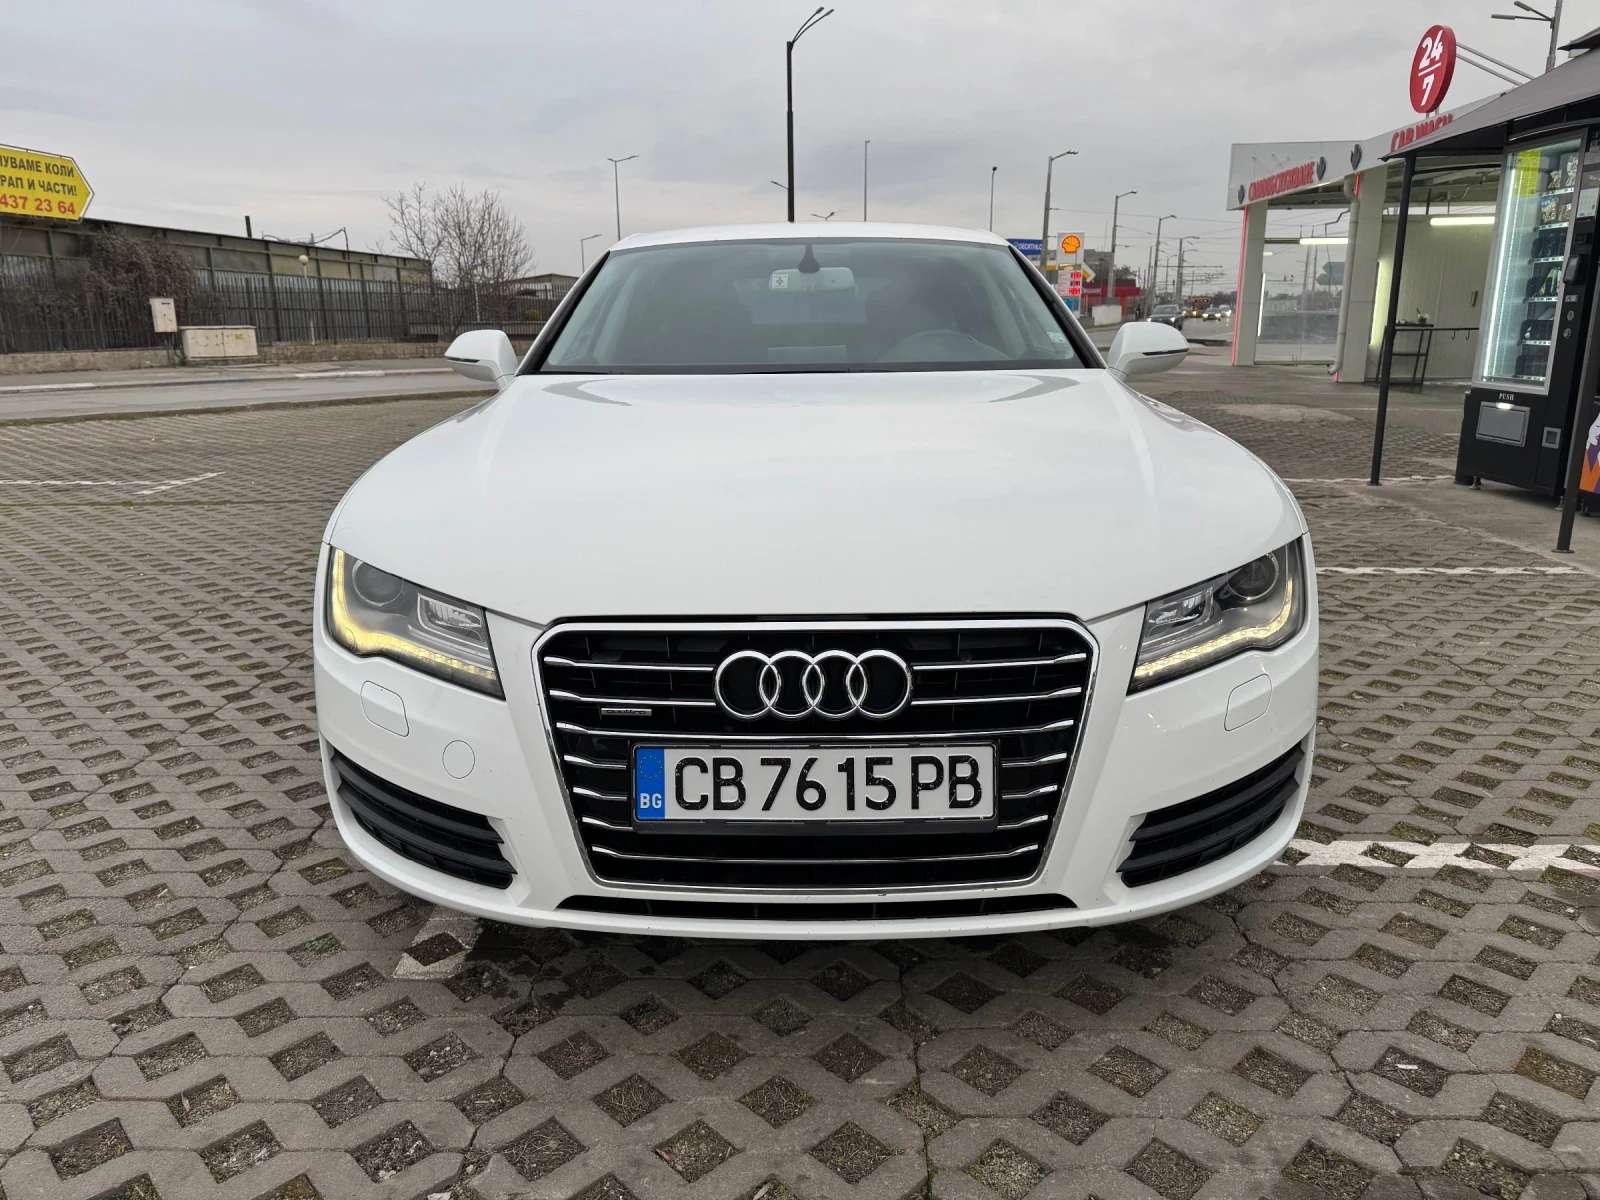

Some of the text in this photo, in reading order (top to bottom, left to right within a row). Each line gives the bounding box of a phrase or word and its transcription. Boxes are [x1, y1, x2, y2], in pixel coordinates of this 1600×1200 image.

[1418, 29, 1444, 70] 24
[1420, 73, 1435, 107] 7
[1389, 126, 1415, 153] CAR
[44, 161, 75, 178] КОЛИ
[27, 178, 36, 191] И
[38, 180, 77, 197] ЧАСТИ!
[0, 193, 76, 215] 437 23 64
[1018, 242, 1043, 251] DECATHLO
[1498, 392, 1515, 401] PUSH
[674, 754, 983, 811] CB 7615 PB
[639, 792, 662, 809] BG
